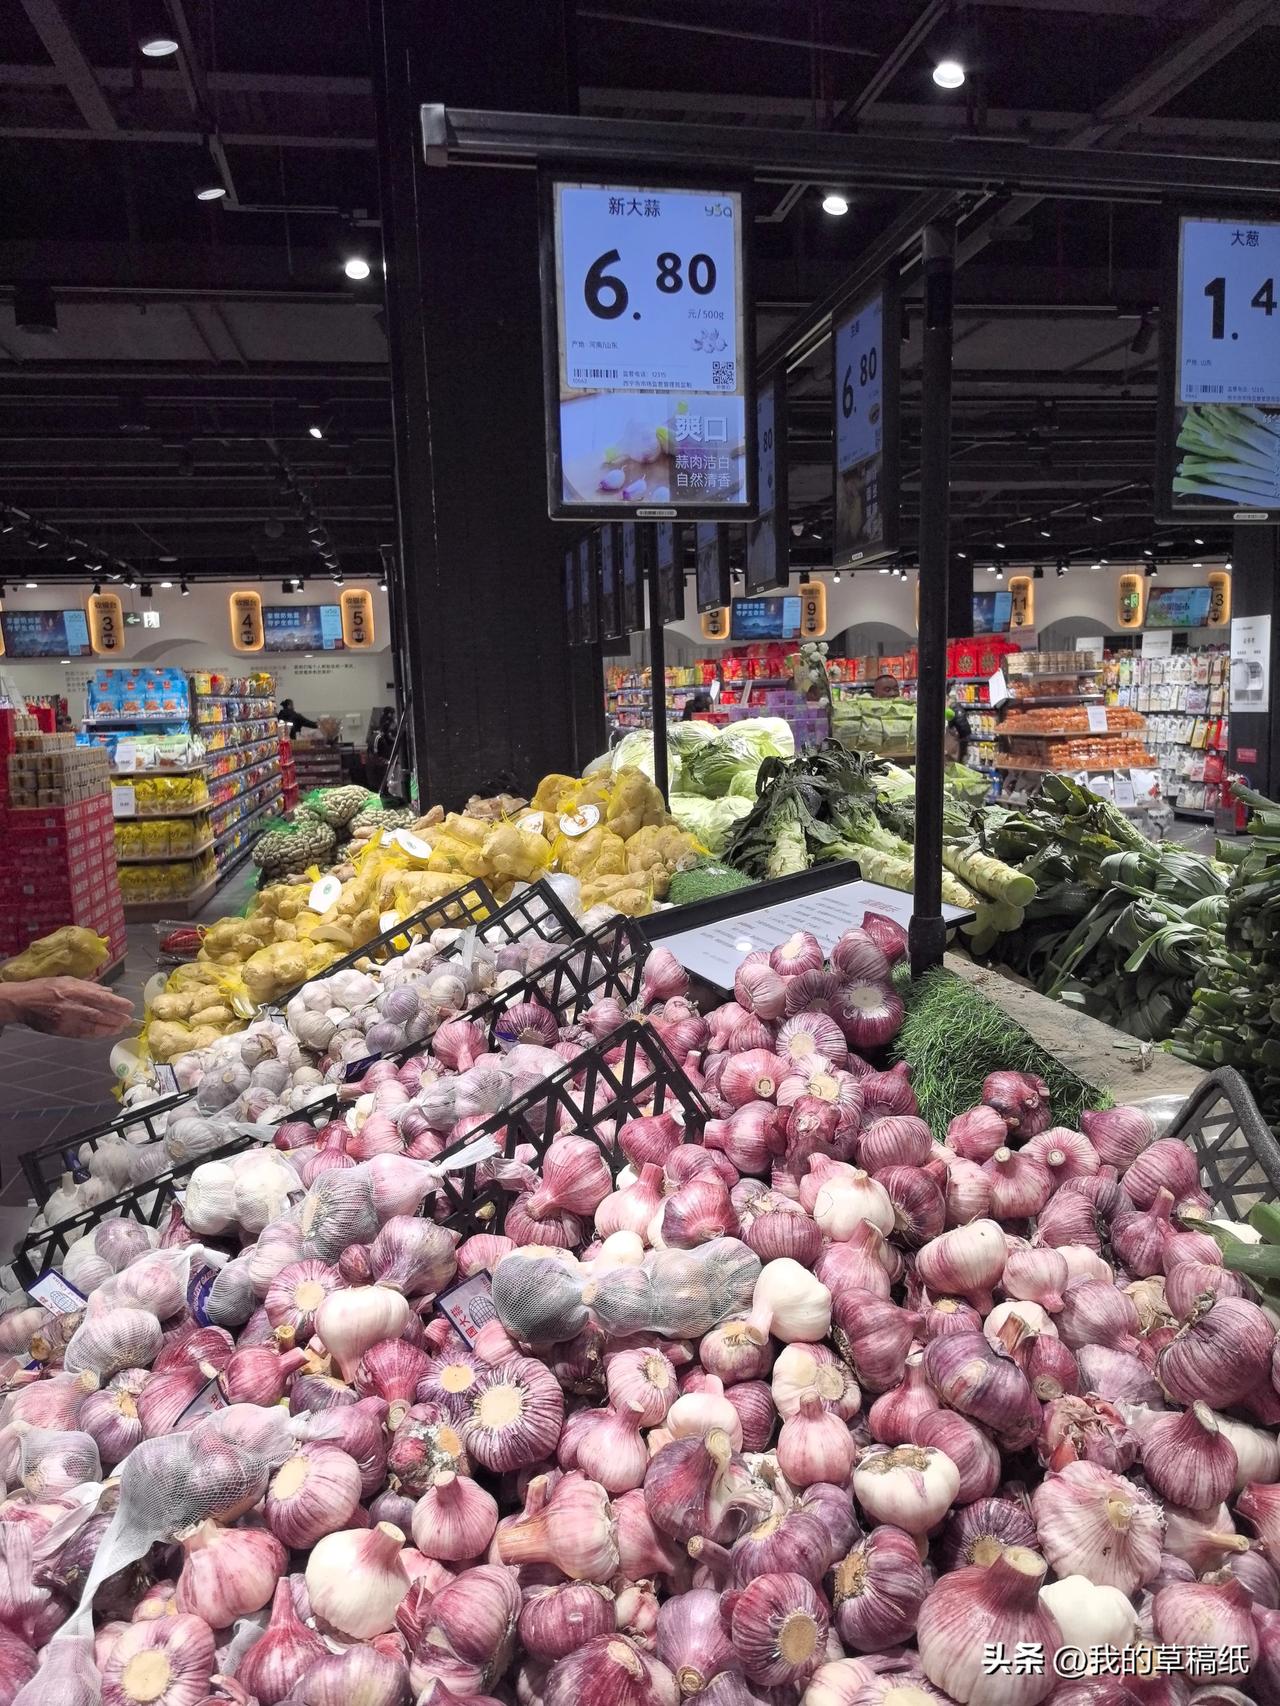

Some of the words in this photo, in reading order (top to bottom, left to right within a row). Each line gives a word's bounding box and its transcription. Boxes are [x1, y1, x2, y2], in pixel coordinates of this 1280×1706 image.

[608, 197, 661, 218] 新大蒜
[1231, 229, 1260, 248] 大葱
[675, 415, 728, 442] 爽口
[675, 454, 730, 470] 蒜肉洁白
[676, 472, 732, 488] 自然清香
[807, 601, 817, 616] 9
[102, 616, 114, 632] 3
[241, 614, 253, 629] 4
[353, 611, 364, 626] 5
